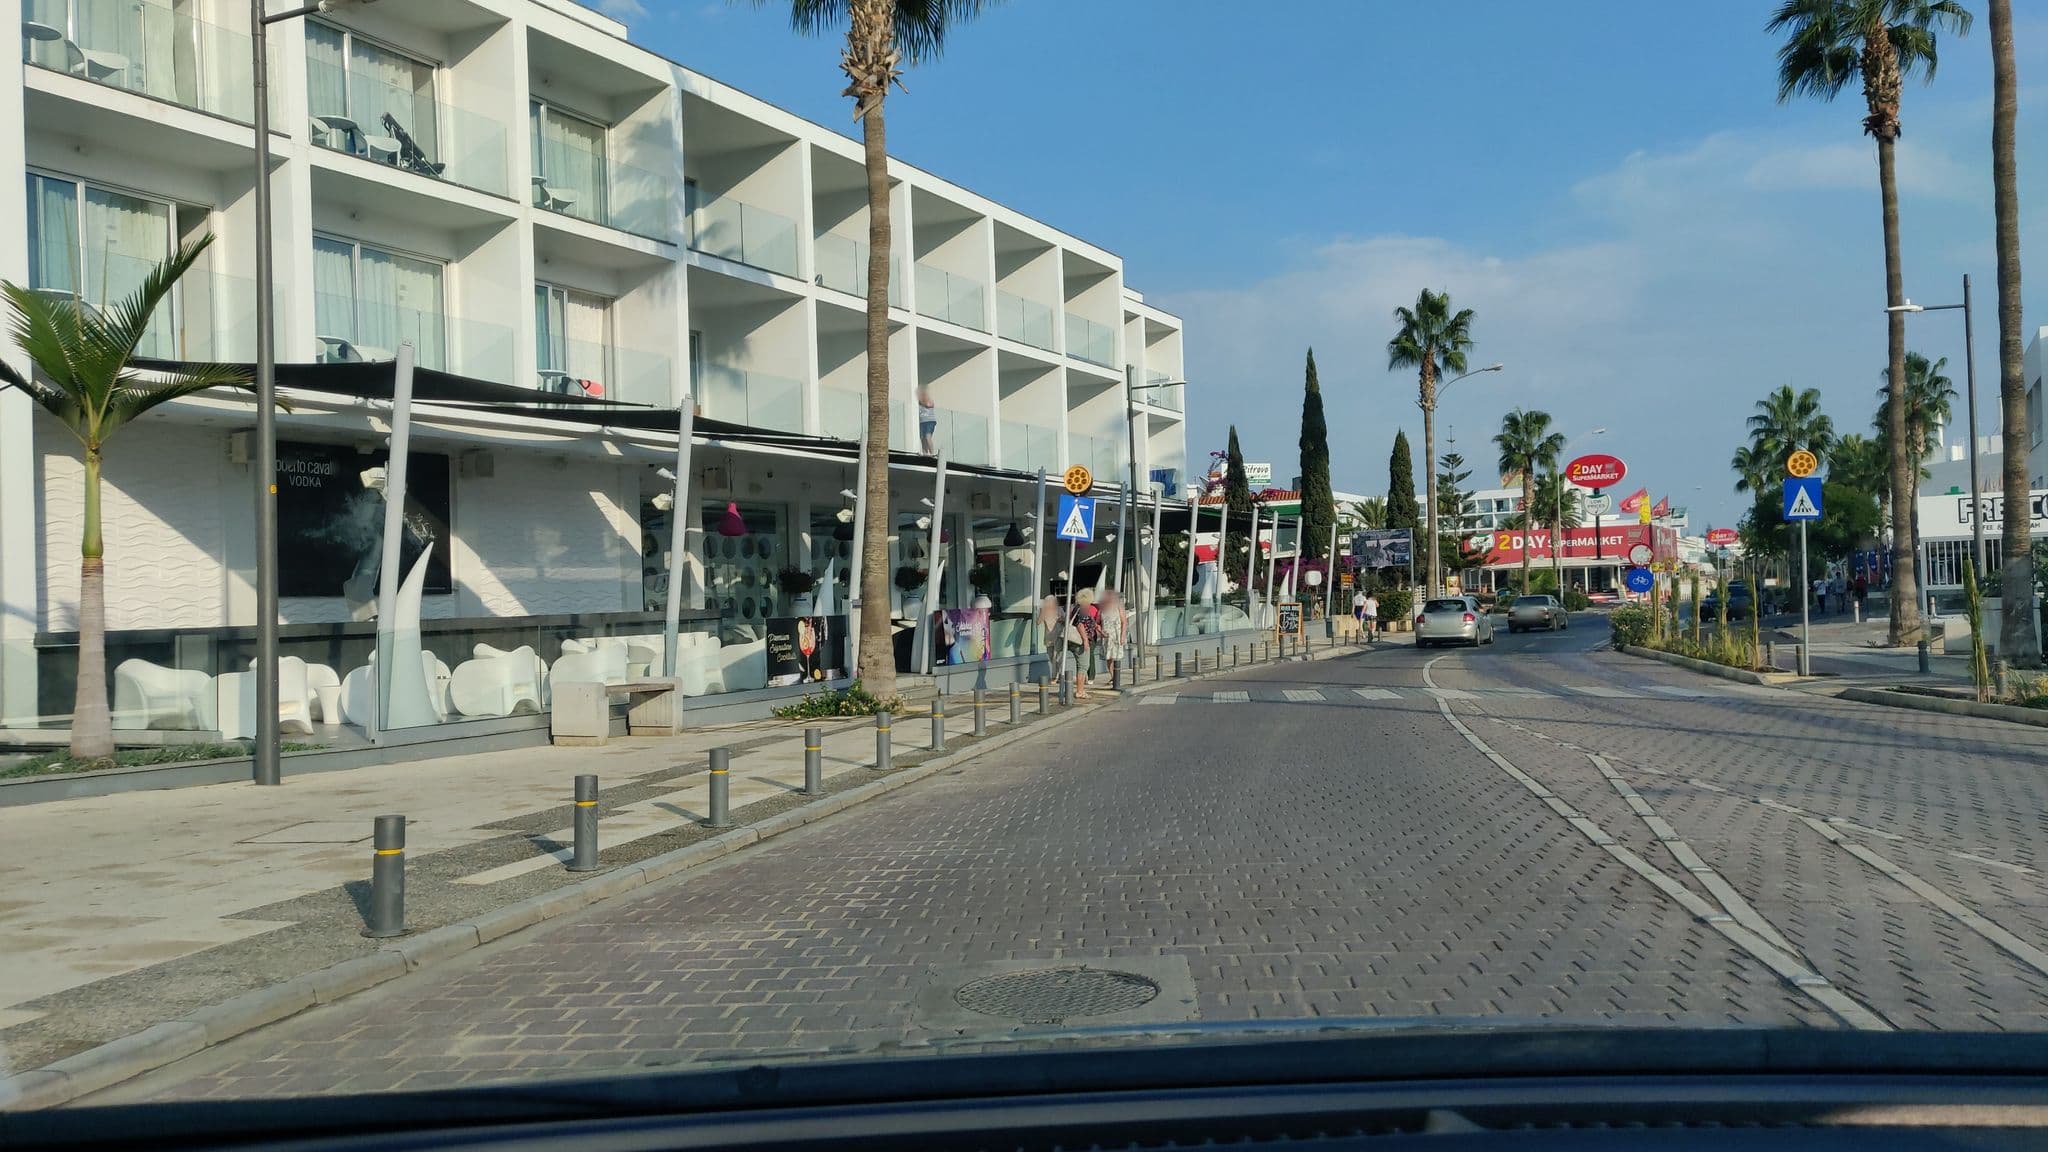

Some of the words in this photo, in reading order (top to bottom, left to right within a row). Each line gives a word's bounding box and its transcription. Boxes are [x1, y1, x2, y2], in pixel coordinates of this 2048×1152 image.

[290, 475, 322, 488] VODKA
[1572, 473, 1619, 481] SUPERMARKET
[1958, 495, 2048, 523] FREC
[1547, 536, 1624, 548] SPERMAKET
